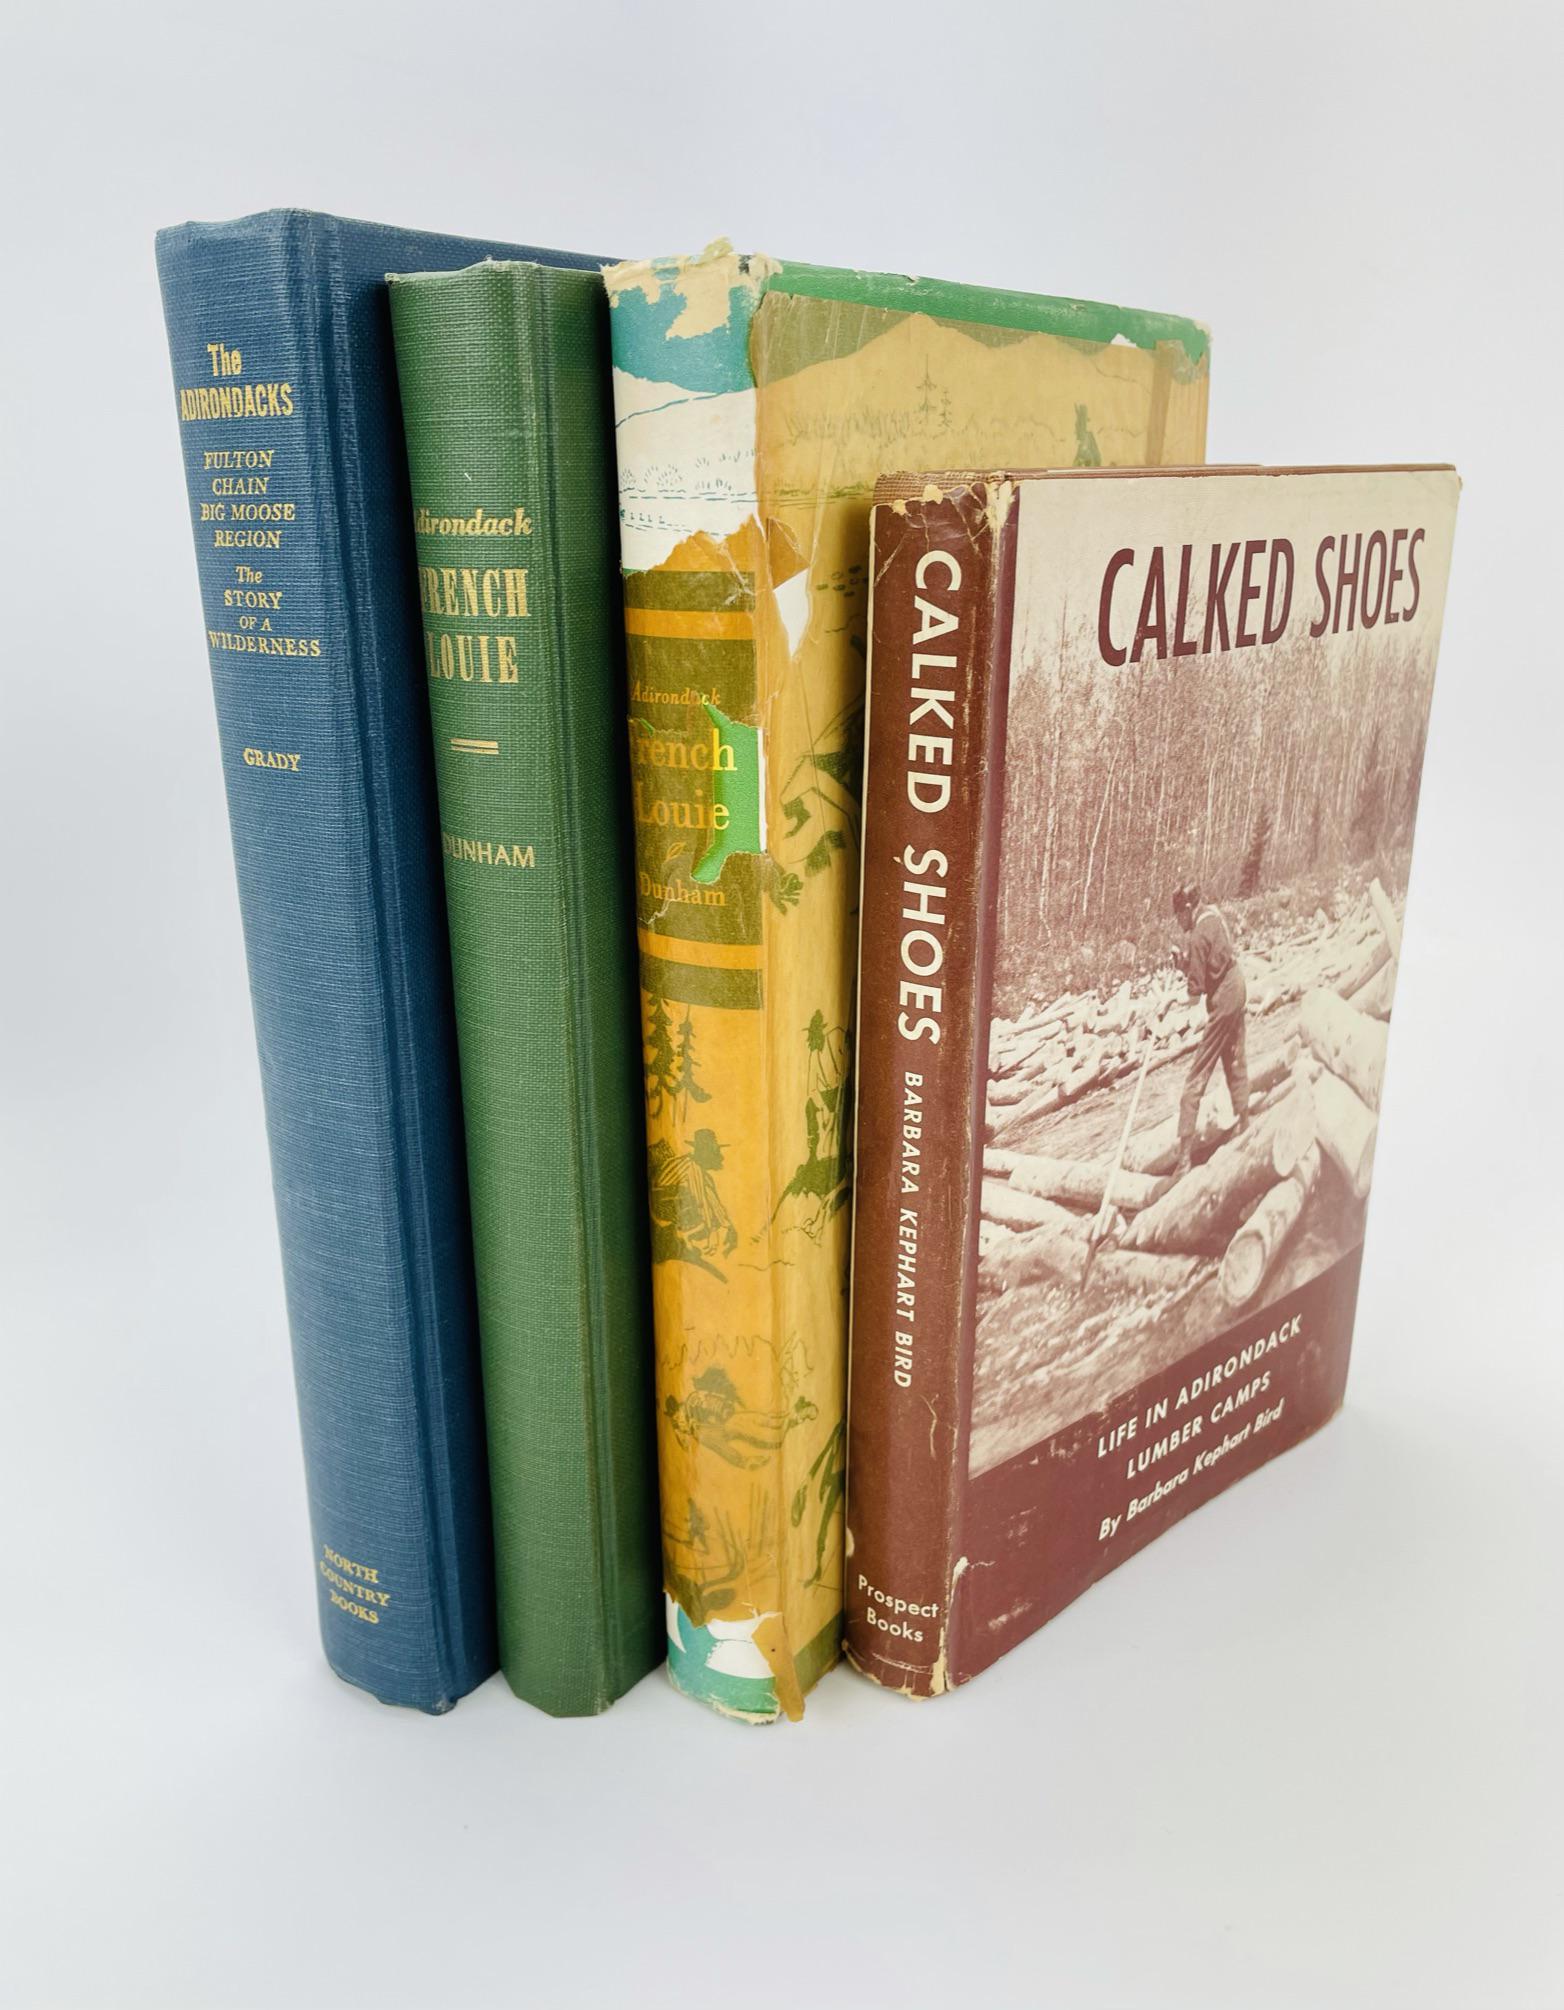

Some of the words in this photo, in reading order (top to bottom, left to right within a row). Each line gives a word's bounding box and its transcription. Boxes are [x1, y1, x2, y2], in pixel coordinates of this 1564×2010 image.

[207, 343, 242, 376] The
[180, 382, 294, 420] ADIRONDACKS
[204, 449, 275, 469] FULTON
[212, 476, 269, 496] CHAIN
[200, 502, 226, 521] BIG
[231, 503, 296, 521] MOOSE
[414, 506, 534, 536] dirondack
[214, 529, 283, 549] REGION
[235, 565, 263, 584] The
[223, 589, 283, 610] STORY
[1097, 537, 1296, 667] CALKED
[1309, 527, 1426, 639] SHOES
[239, 615, 257, 630] OF
[260, 617, 273, 632] A
[208, 630, 322, 658] WILDERNESS
[427, 632, 520, 684] LOUIE
[632, 681, 721, 705] Adirondack
[906, 548, 963, 814] CALKED
[243, 747, 301, 772] GRADY
[637, 728, 738, 771] rench
[636, 779, 730, 831] Louie
[639, 870, 728, 907] Dunham
[897, 845, 949, 1046] SHOES
[901, 1071, 924, 1194] BARBARA
[896, 1207, 918, 1322] KEPHART
[894, 1330, 913, 1388] BIRD
[1097, 1415, 1138, 1458] LIFE
[1144, 1397, 1169, 1429] IN
[1175, 1313, 1302, 1410] ADIRONDACK
[1126, 1415, 1204, 1480] LUMBER
[1210, 1370, 1271, 1424] CAMPS
[1098, 1513, 1123, 1541] By
[1126, 1467, 1189, 1522] Barbara
[1193, 1422, 1251, 1475] Kephart
[1253, 1396, 1285, 1434] Bird
[323, 1543, 380, 1584] NORTH
[319, 1560, 391, 1608] COUNTRY
[858, 1573, 940, 1618] Prospect
[329, 1588, 380, 1625] BOOKS
[866, 1606, 924, 1643] Books
